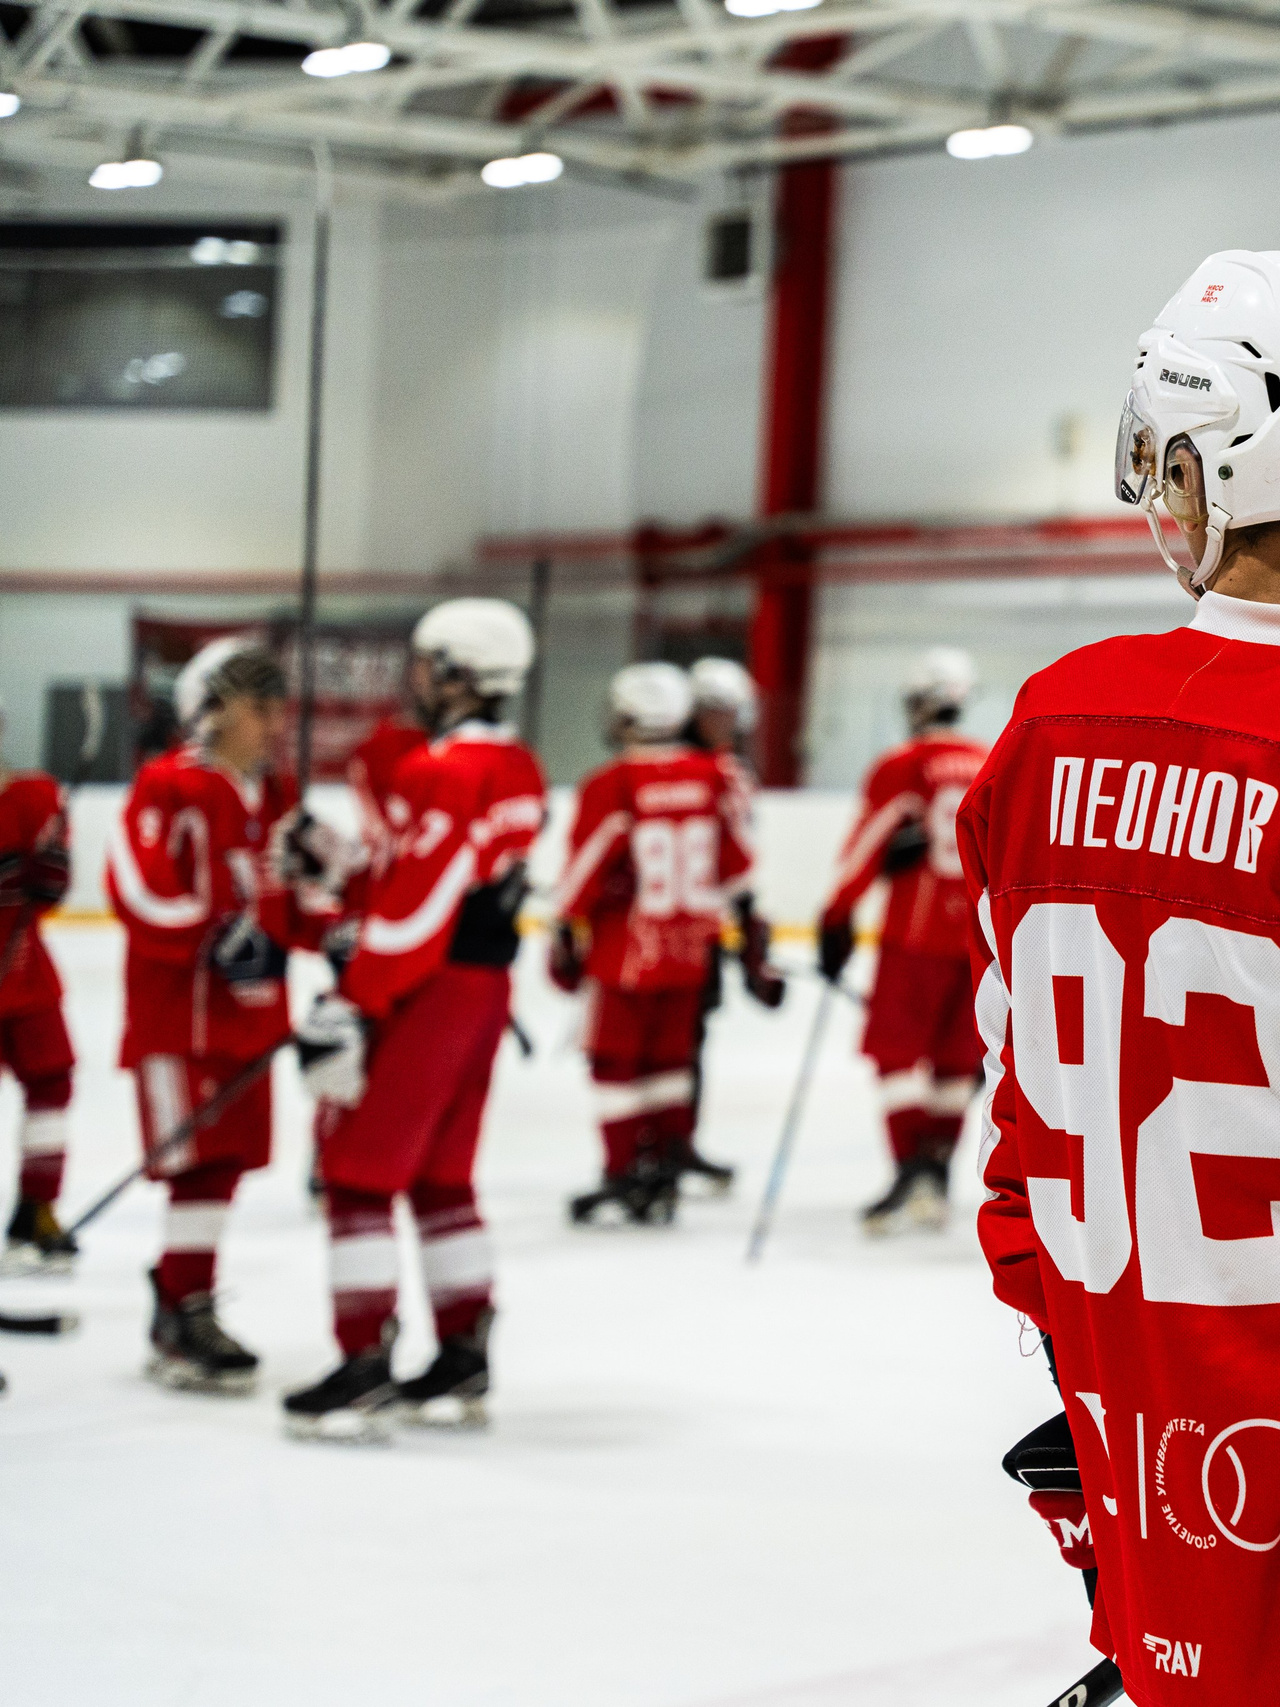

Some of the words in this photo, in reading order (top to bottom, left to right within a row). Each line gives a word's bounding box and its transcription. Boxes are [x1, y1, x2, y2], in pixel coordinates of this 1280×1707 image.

[1159, 368, 1213, 392] BAUER
[1155, 1418, 1205, 1496] УНИВЕРСИТЕТА
[1161, 1503, 1217, 1550] СТОЛЕТИЕ
[1142, 1632, 1202, 1678] RAY
